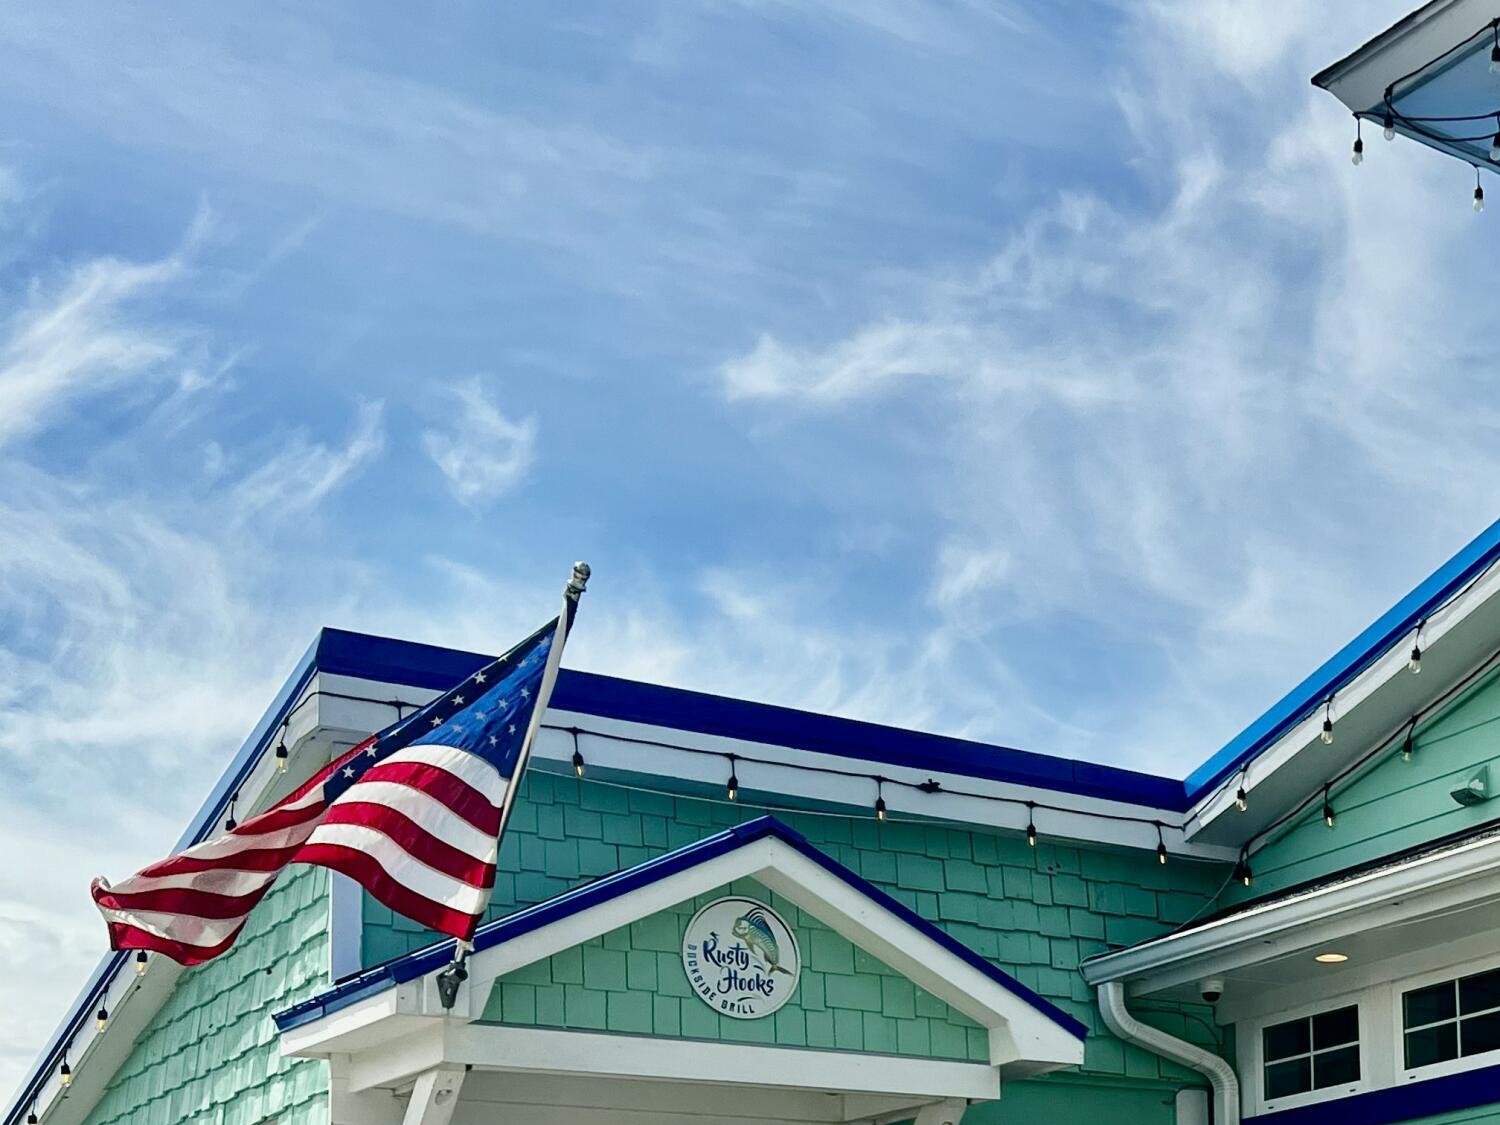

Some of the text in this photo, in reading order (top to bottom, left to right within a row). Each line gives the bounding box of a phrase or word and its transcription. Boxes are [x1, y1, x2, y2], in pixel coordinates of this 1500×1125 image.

[703, 938, 750, 971] Rusty
[687, 943, 755, 1014] DOCKSIDE GRILL
[717, 966, 774, 997] Hooks
